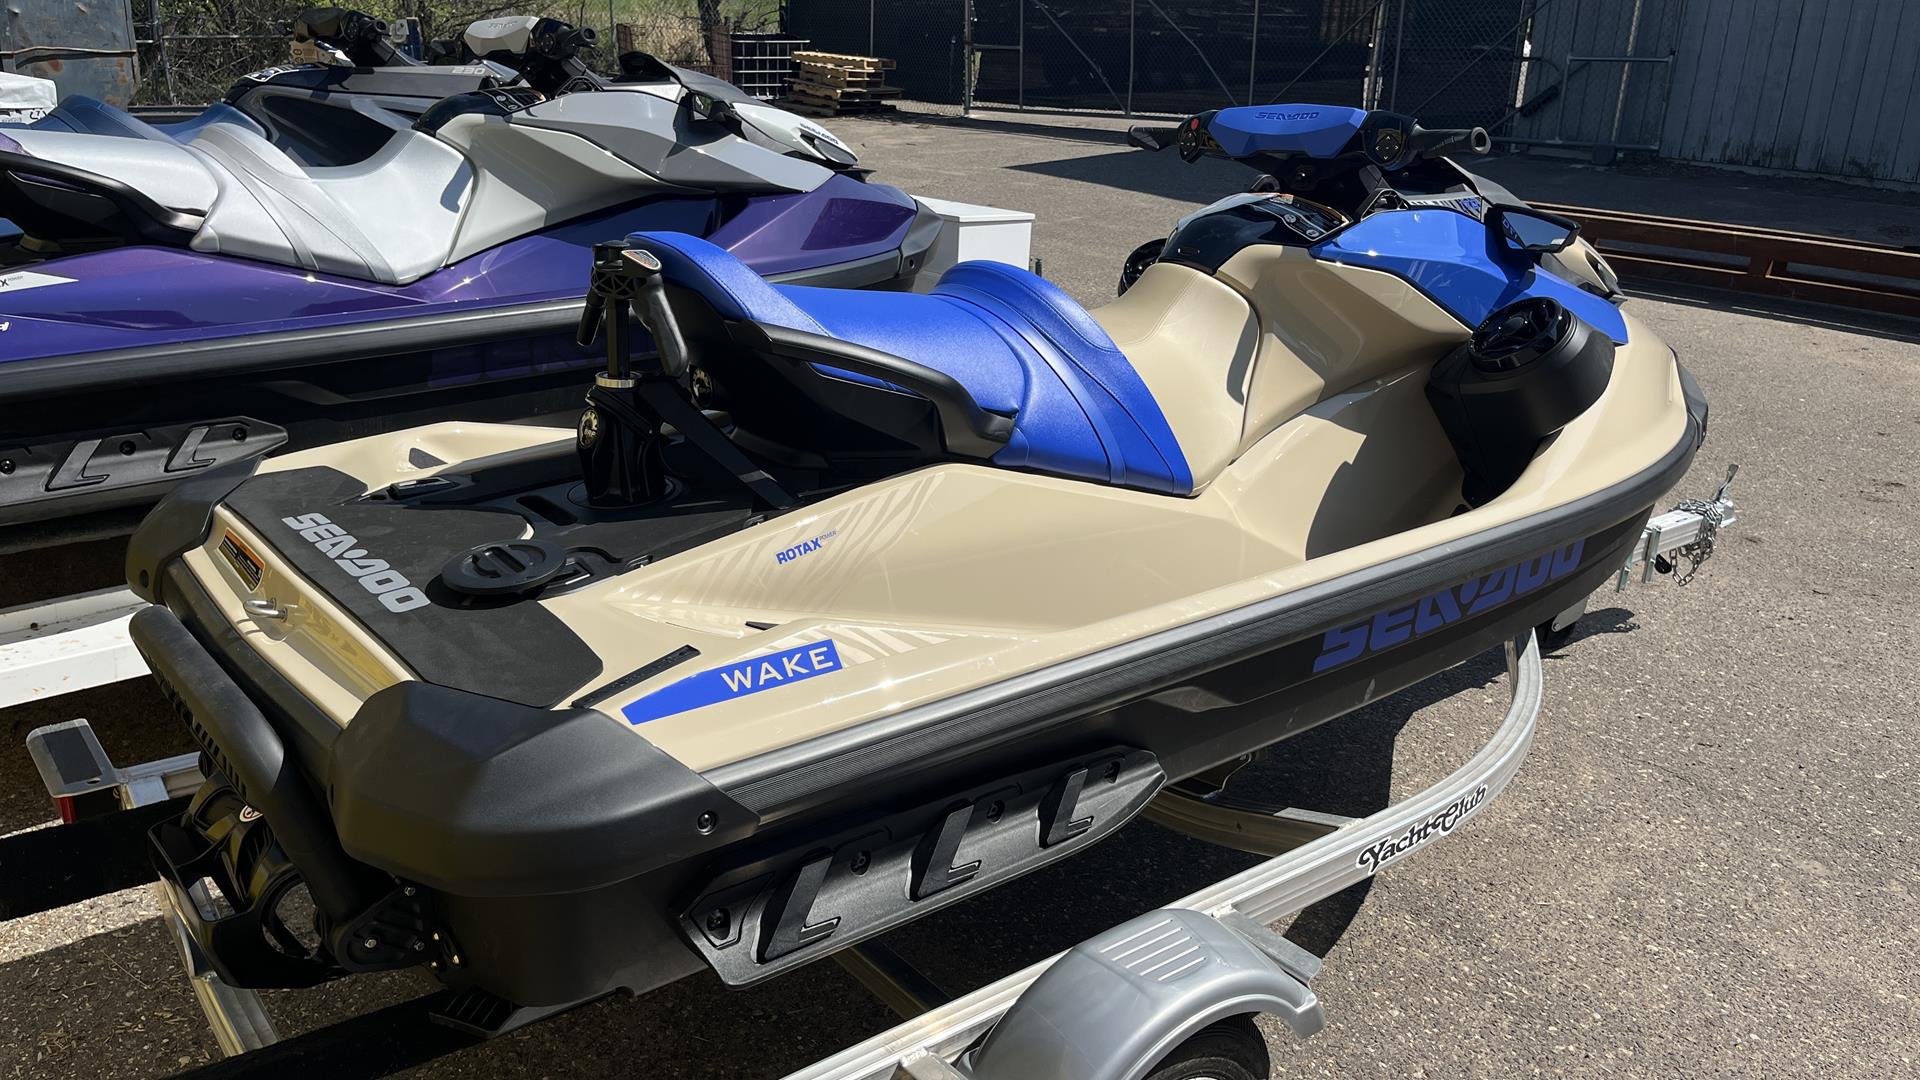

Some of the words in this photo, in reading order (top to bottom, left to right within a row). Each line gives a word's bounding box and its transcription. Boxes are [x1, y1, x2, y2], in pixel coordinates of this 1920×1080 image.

[451, 67, 486, 75] 230
[776, 537, 822, 565] ROTAX
[720, 646, 834, 692] WAKE
[1358, 818, 1431, 873] Yacht
[1431, 786, 1487, 832] Club
